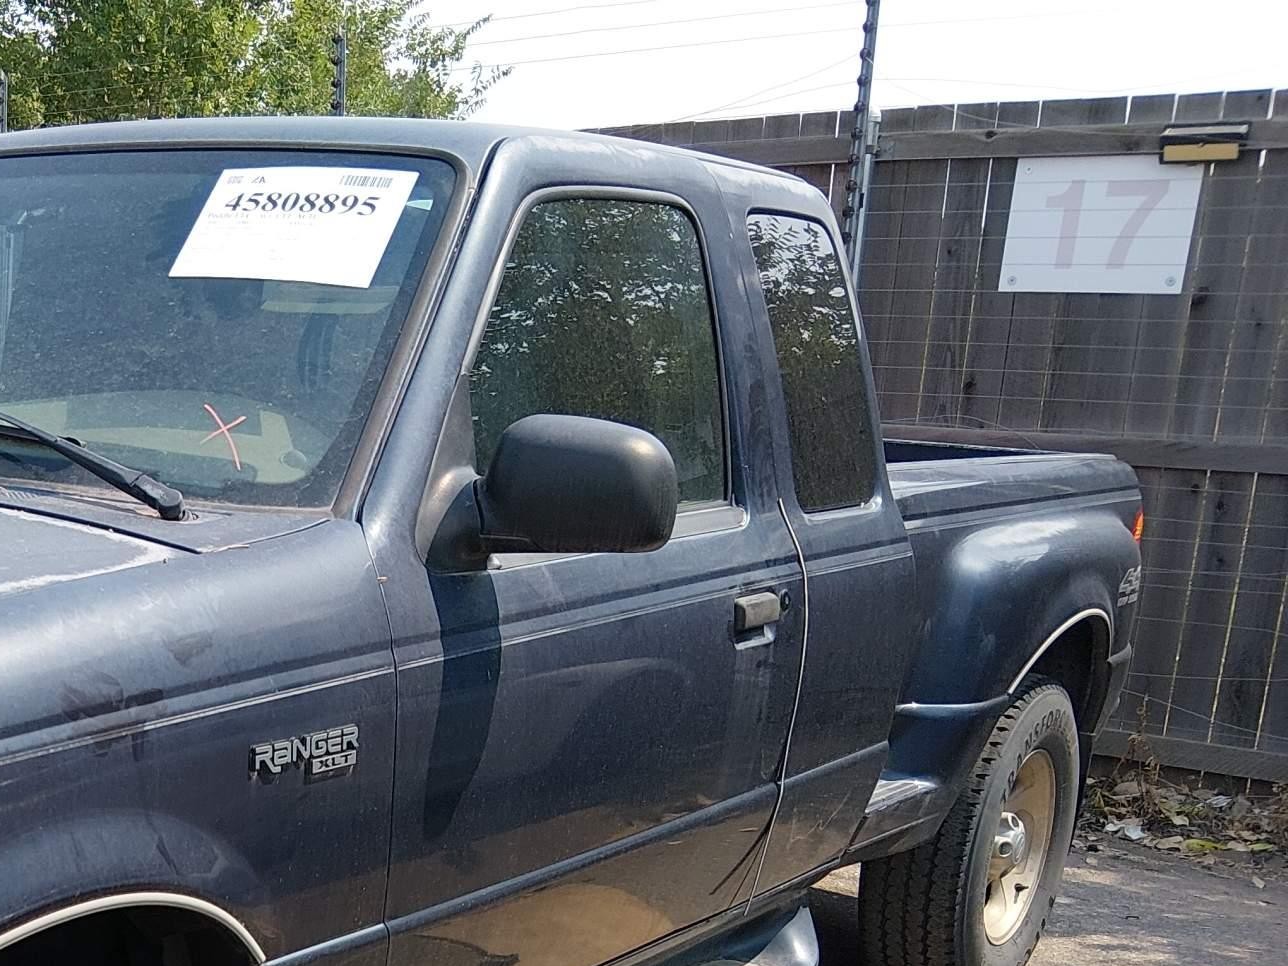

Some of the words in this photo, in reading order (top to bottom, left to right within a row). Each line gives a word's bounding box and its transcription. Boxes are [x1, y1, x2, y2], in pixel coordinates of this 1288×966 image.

[224, 191, 382, 216] 45808895
[1045, 179, 1171, 270] 17
[252, 724, 359, 773] RANGER
[316, 752, 353, 771] XLT
